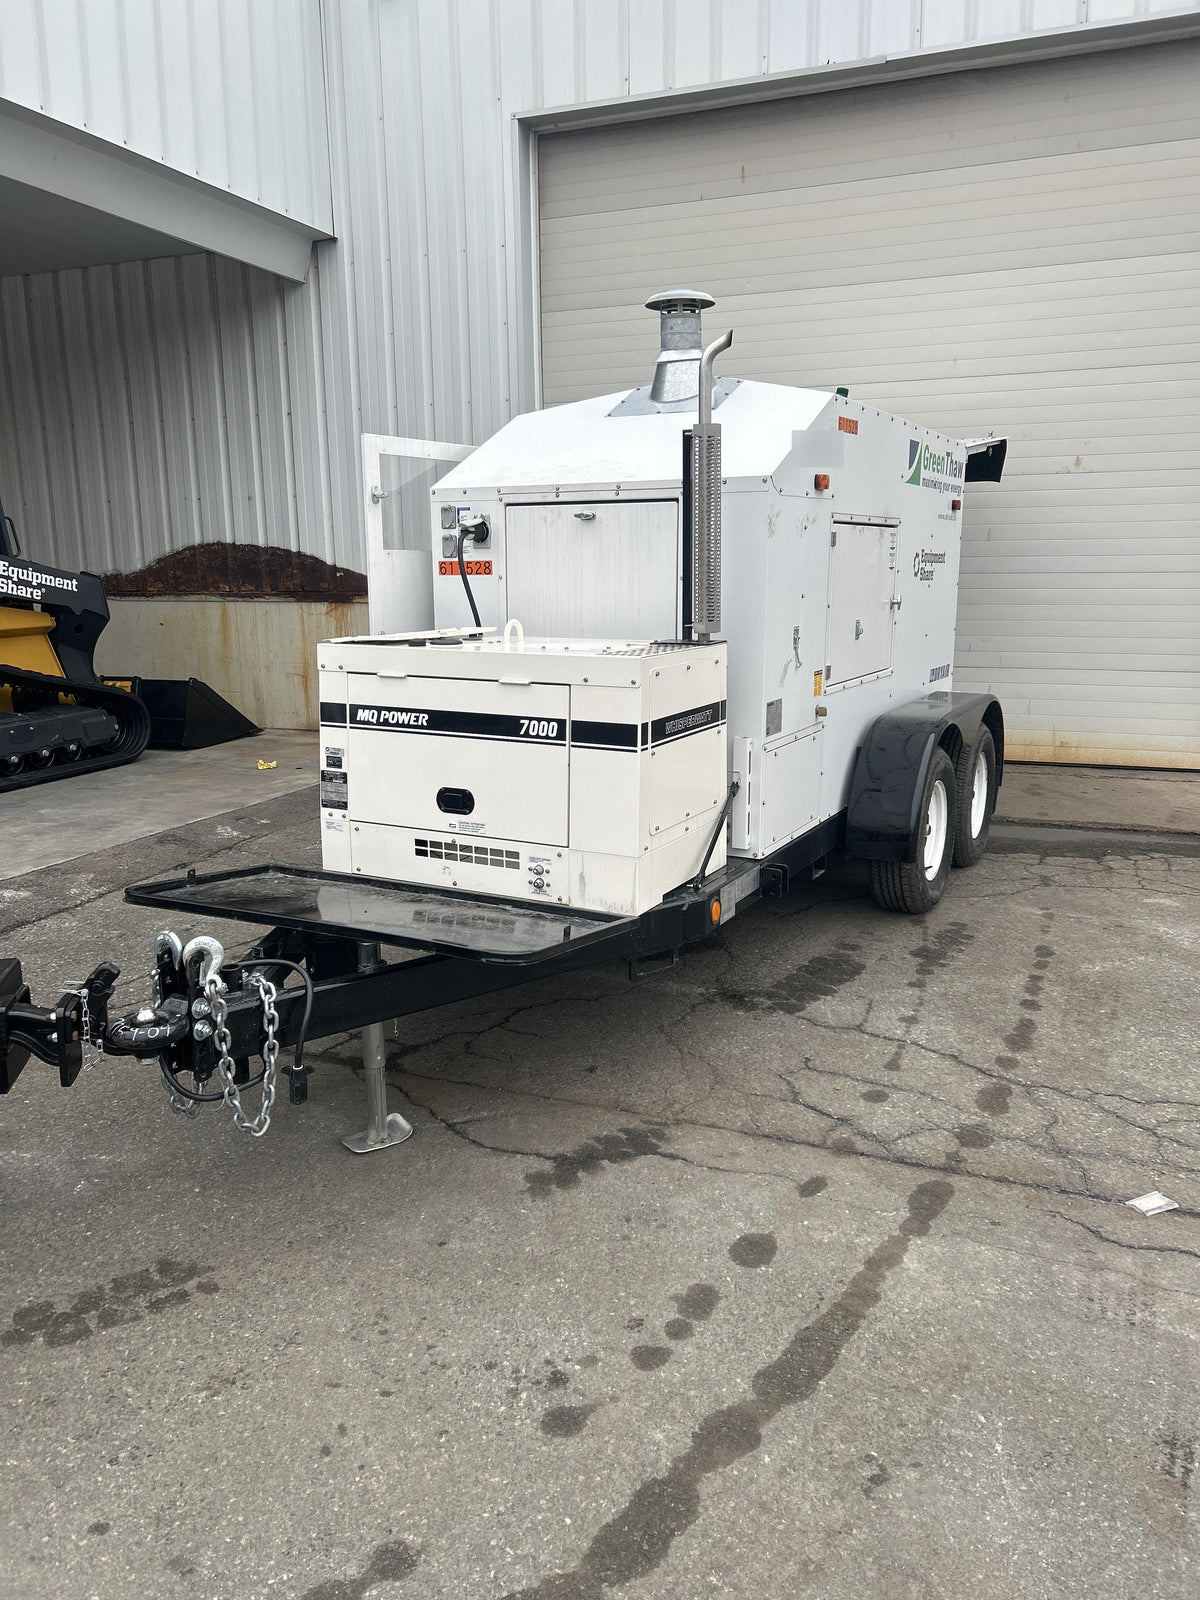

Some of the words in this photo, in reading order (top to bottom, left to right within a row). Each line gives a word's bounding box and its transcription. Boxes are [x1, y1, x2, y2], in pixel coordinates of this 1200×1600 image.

[921, 549, 946, 567] Equipment
[0, 560, 78, 592] Equipment
[440, 561, 492, 576] 61528
[356, 708, 378, 724] MQ
[380, 710, 429, 726] POWER
[519, 719, 558, 737] 7000
